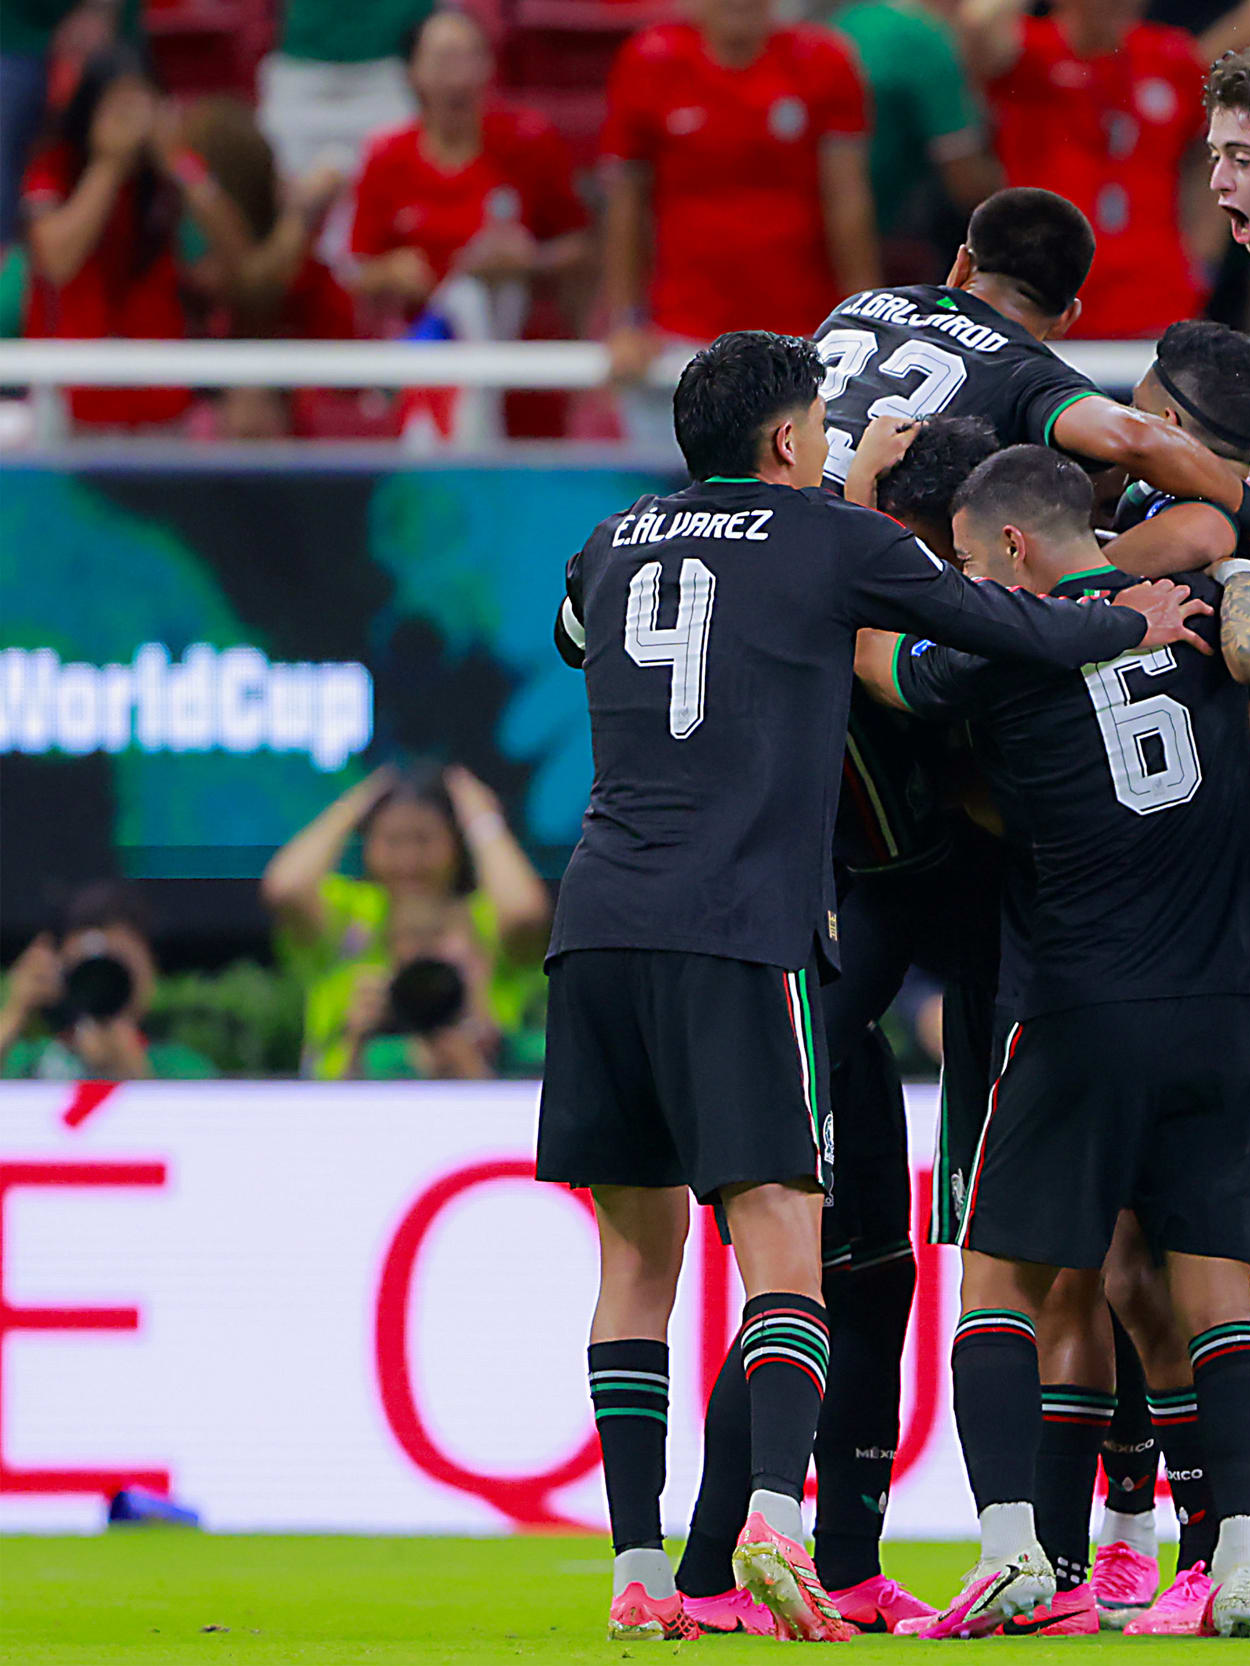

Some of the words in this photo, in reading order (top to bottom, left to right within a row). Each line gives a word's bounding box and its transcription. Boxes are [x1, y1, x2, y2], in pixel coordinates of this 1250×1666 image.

[612, 506, 774, 548] E.ÁLVAREZ
[0, 642, 374, 773] WorldCup
[624, 558, 717, 740] 4
[1080, 645, 1202, 816] 6
